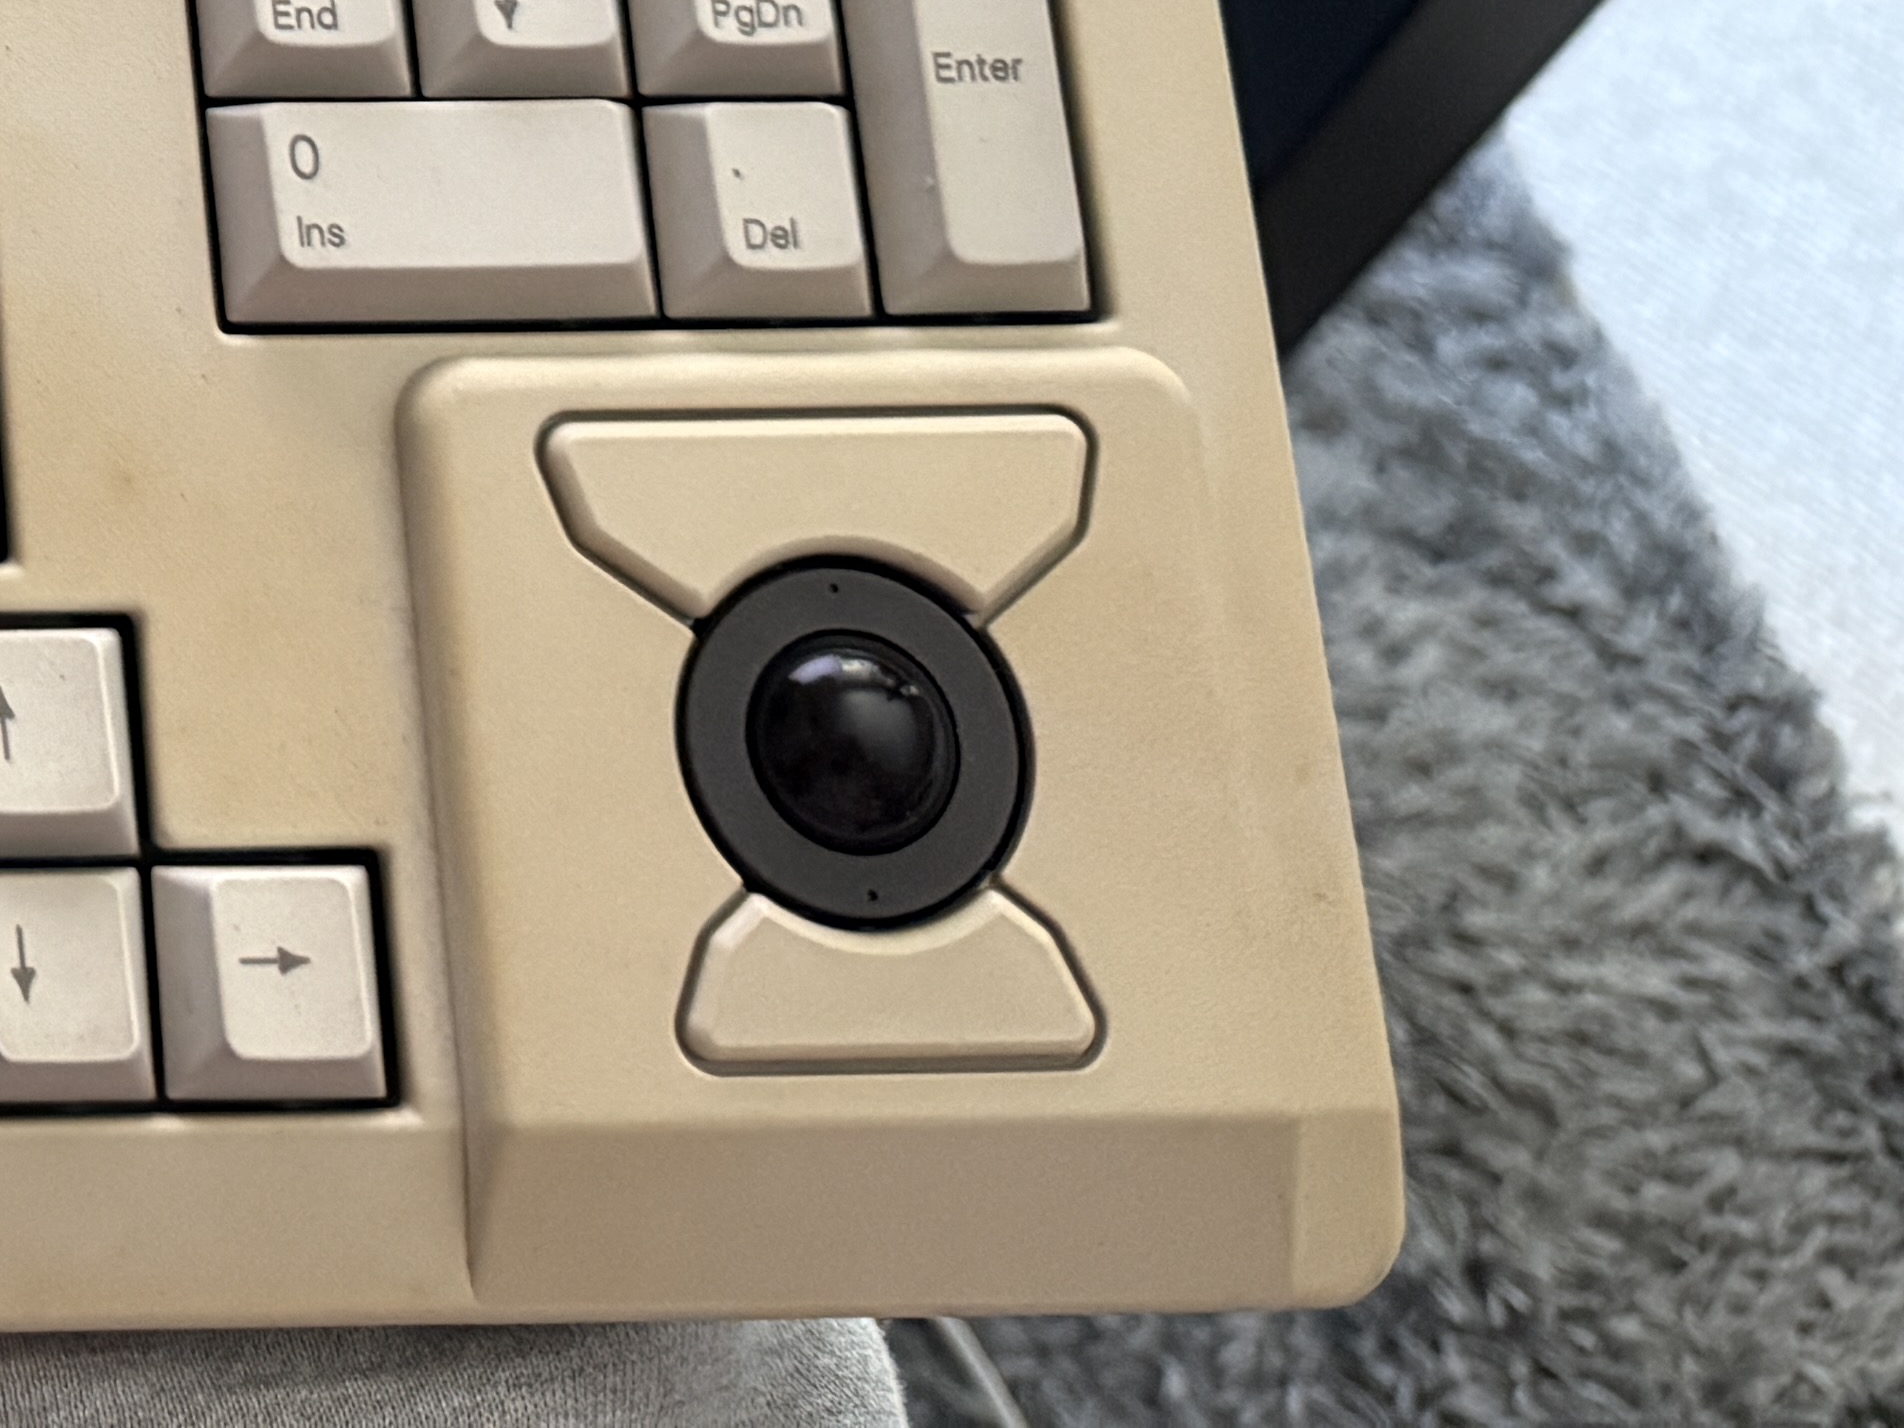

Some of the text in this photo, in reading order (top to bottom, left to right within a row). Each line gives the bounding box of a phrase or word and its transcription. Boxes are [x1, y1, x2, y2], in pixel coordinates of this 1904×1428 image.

[931, 51, 1023, 85] Enter
[288, 133, 321, 181] 0
[296, 215, 347, 249] Ins
[742, 217, 801, 251] Del
